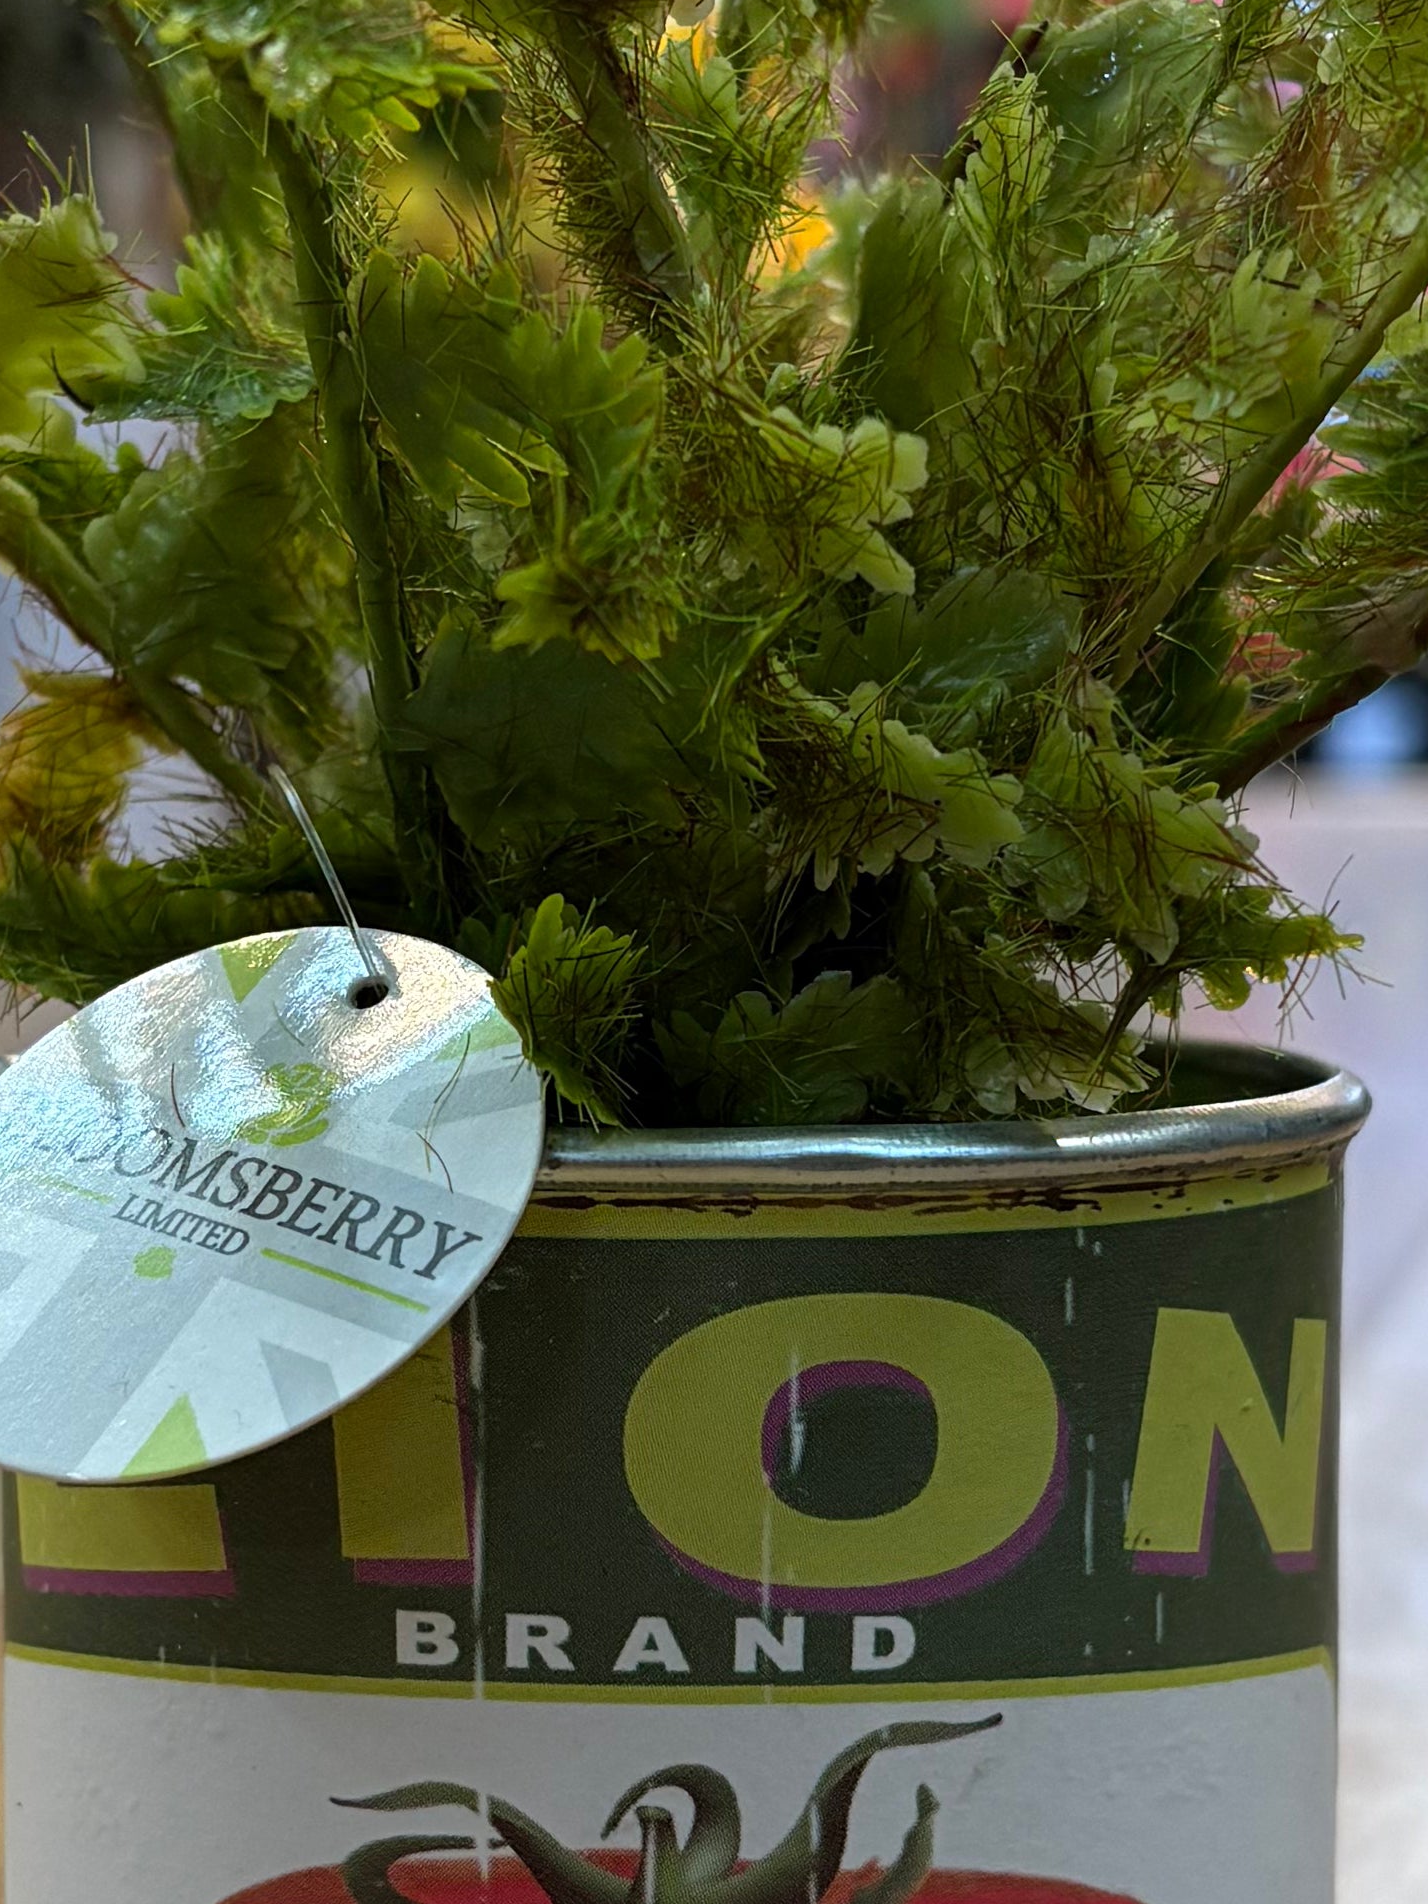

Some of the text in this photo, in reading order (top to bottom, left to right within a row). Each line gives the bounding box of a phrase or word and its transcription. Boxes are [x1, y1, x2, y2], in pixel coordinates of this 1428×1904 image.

[27, 1111, 483, 1281] OMSBERRY
[112, 1193, 250, 1256] LIMITED
[394, 1608, 917, 1675] BRAND
